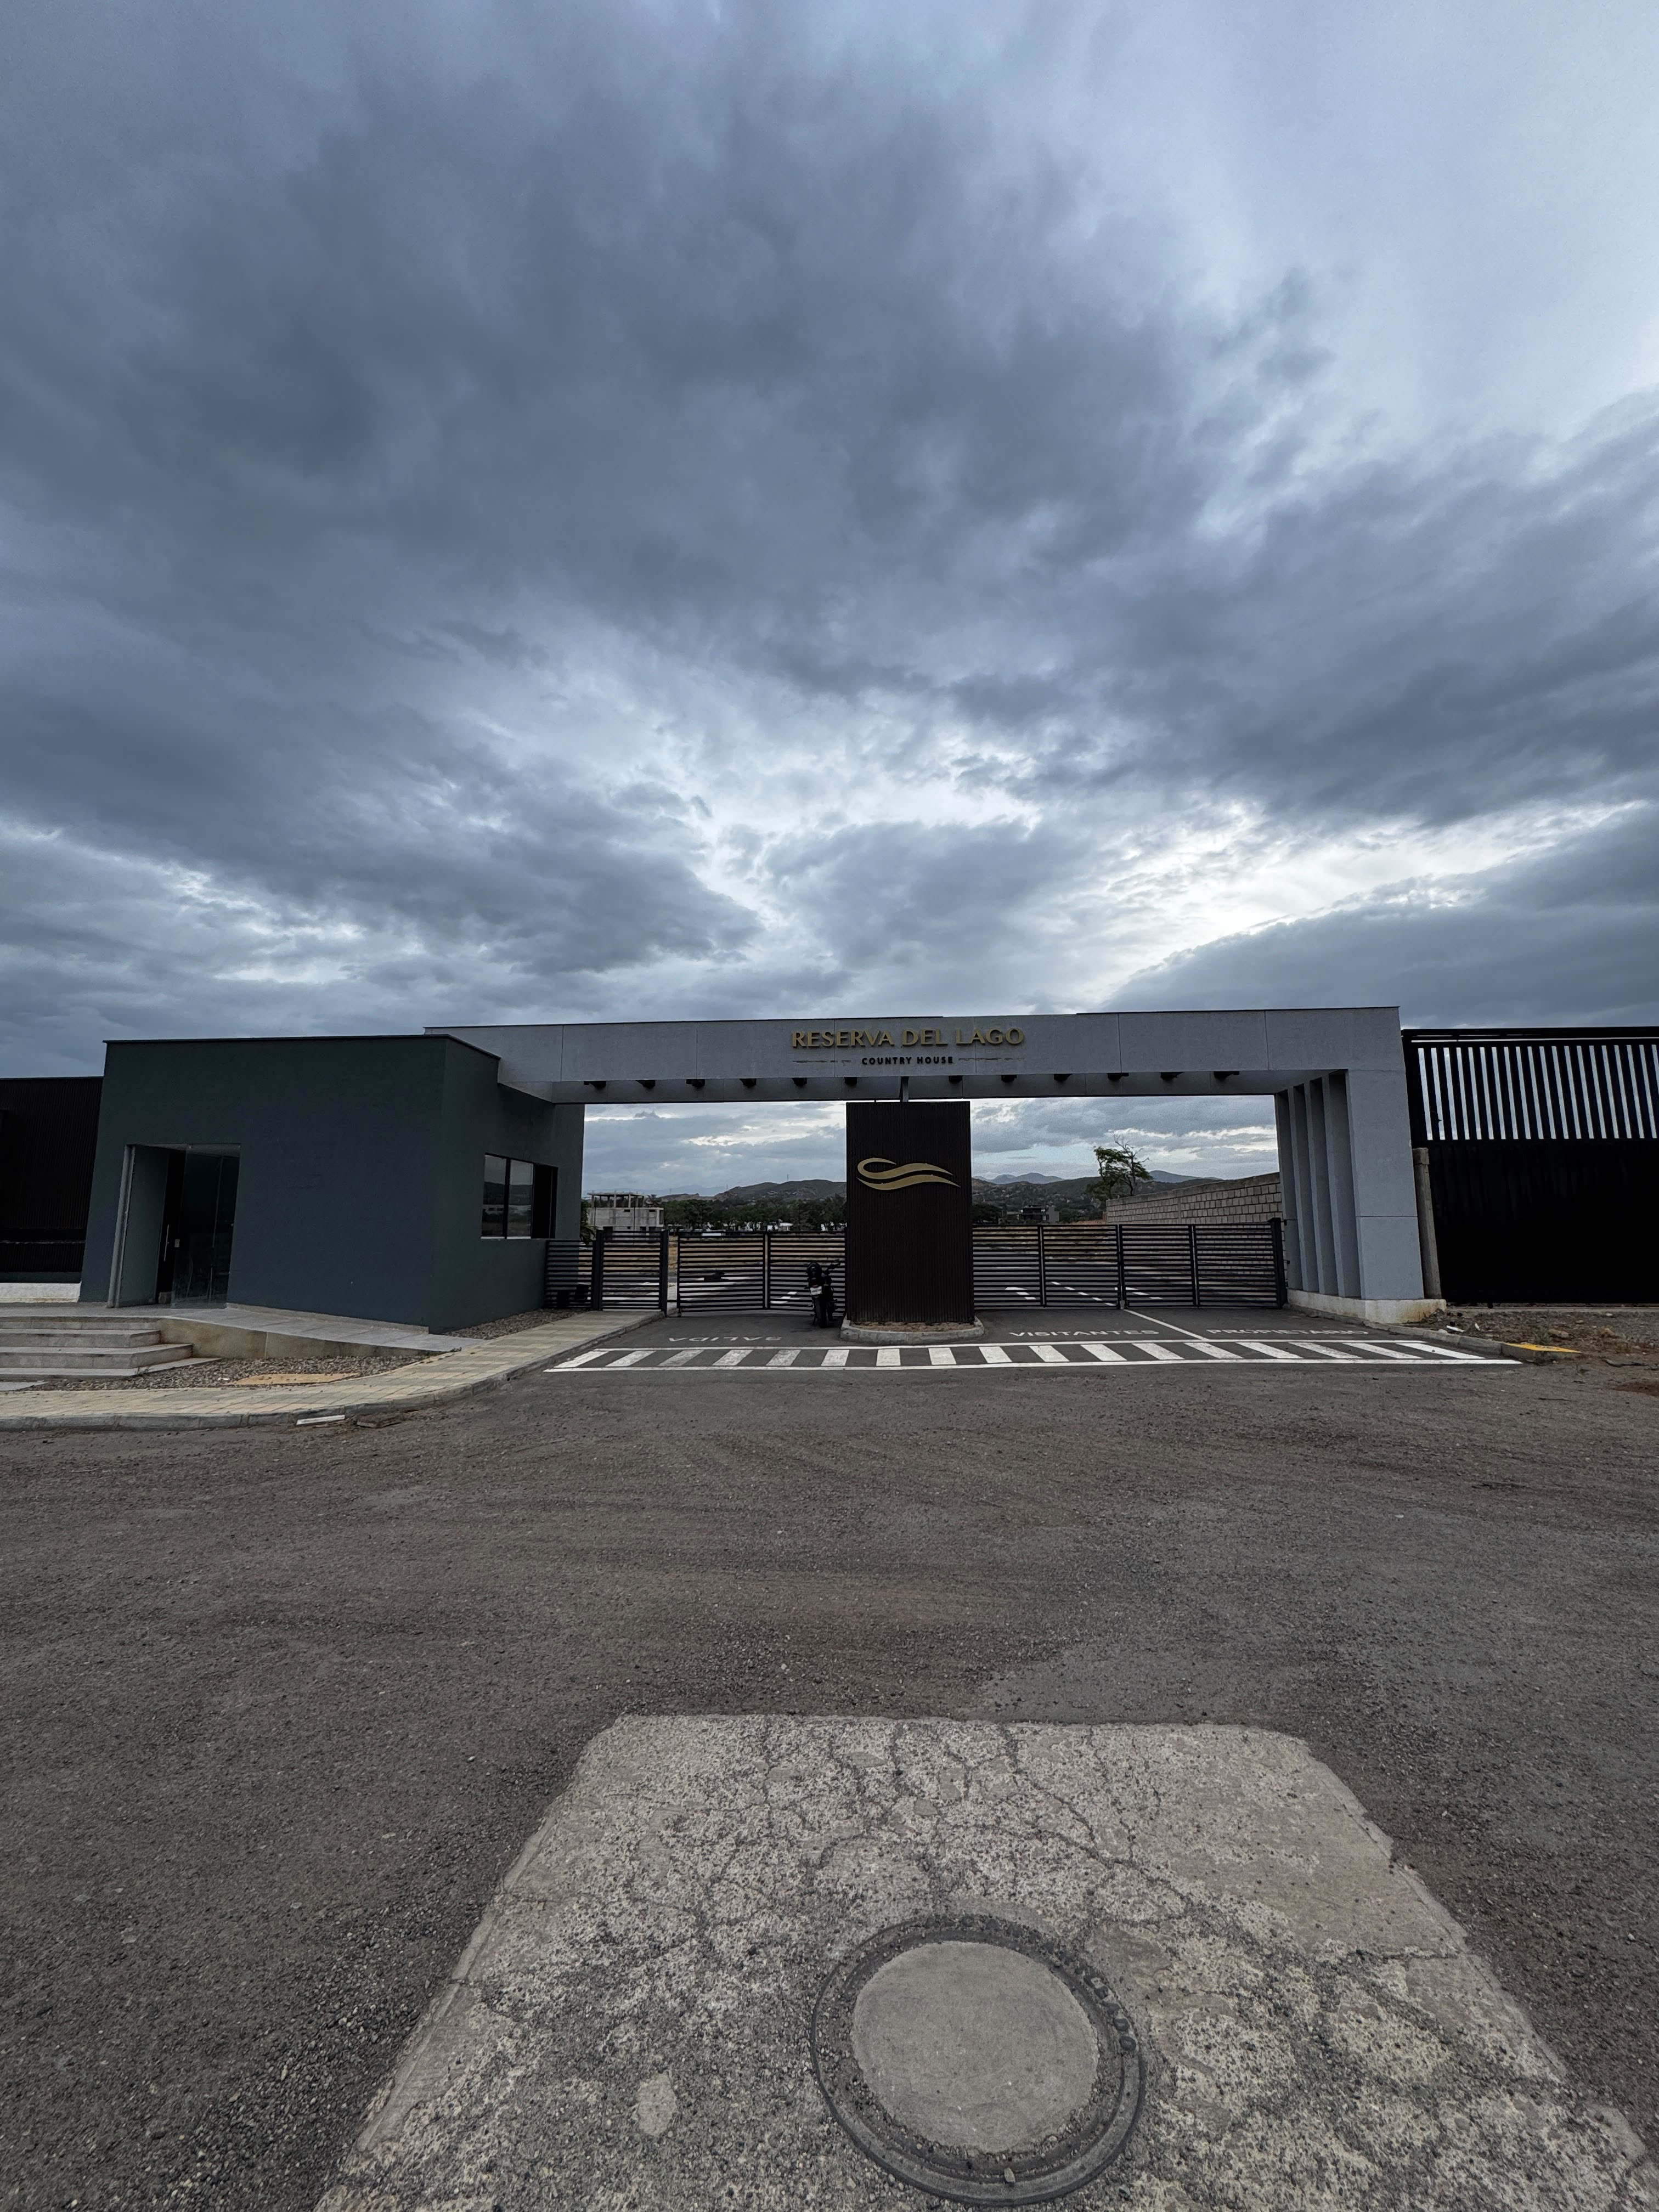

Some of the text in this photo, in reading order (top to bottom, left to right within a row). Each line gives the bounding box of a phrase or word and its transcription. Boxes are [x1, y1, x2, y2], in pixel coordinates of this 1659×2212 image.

[792, 1028, 1025, 1047] RESERVA DEL LAGO
[862, 1057, 912, 1065] COUNTRY
